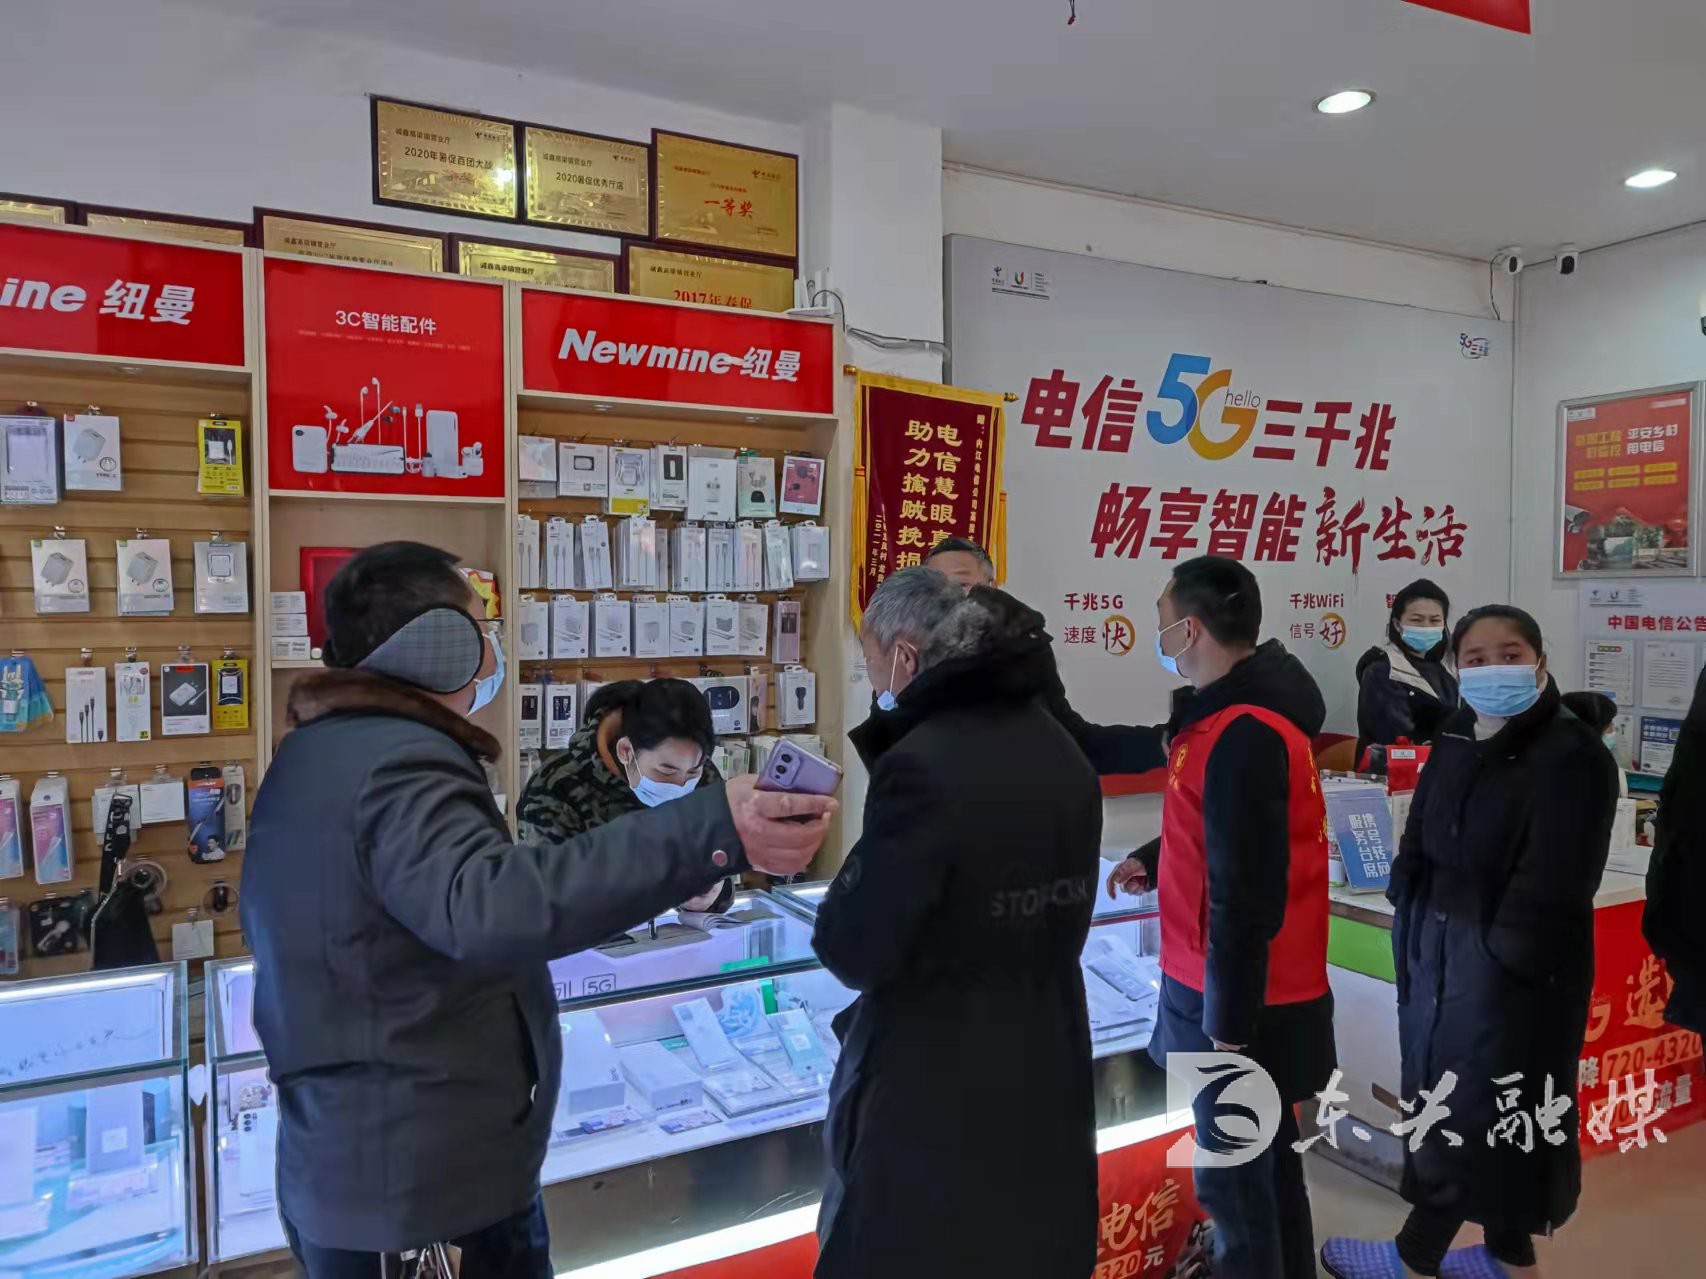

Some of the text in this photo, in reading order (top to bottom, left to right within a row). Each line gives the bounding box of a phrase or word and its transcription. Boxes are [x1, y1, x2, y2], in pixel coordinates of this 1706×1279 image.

[704, 197, 753, 219] 一等奖
[0, 277, 196, 326] ine 纽曼
[335, 310, 438, 336] 3C智能配件
[558, 328, 800, 383] Newmine 纽曼
[1225, 389, 1261, 408] hello
[1627, 424, 1678, 440] 平安乡村
[1627, 440, 1665, 455] 用电信
[1090, 482, 1469, 575] 畅享智能新生活
[1064, 592, 1124, 611] 千兆5G
[1289, 593, 1344, 609] 千兆WiFi
[1607, 614, 1706, 632] 中国电信公告
[588, 979, 612, 995] 5G
[1098, 1178, 1181, 1251] 电信
